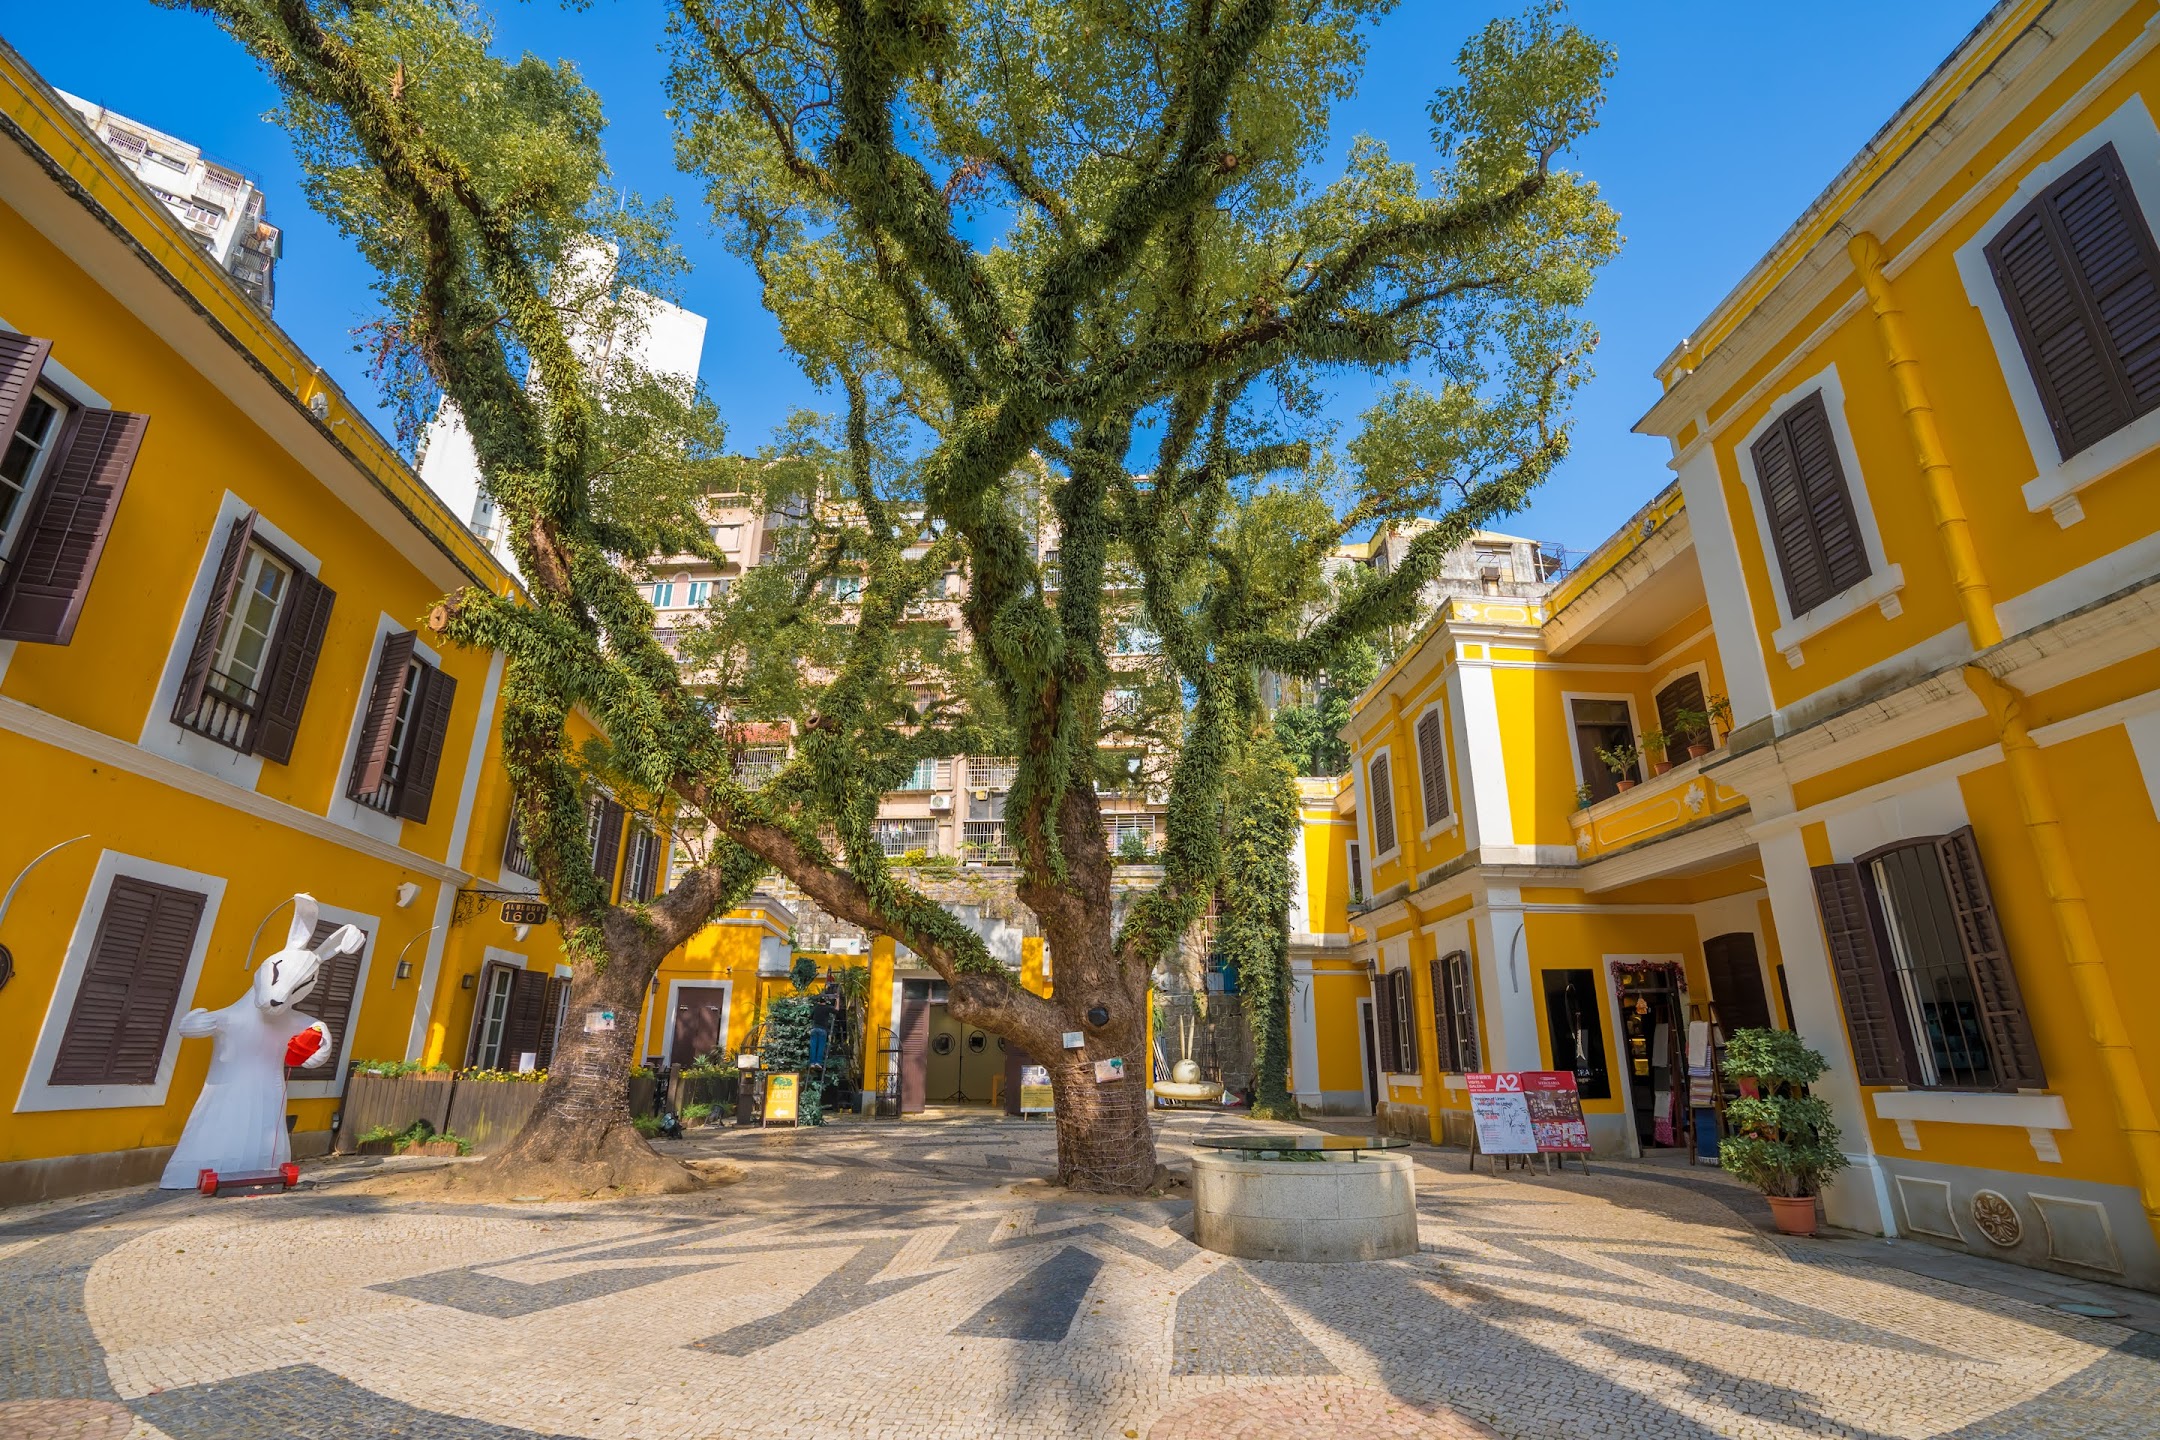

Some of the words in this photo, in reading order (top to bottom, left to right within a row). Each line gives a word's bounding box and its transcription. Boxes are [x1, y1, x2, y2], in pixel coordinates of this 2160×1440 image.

[505, 904, 547, 912] ALBERGUE
[505, 911, 545, 923] 1601
[1495, 1074, 1520, 1092] A2
